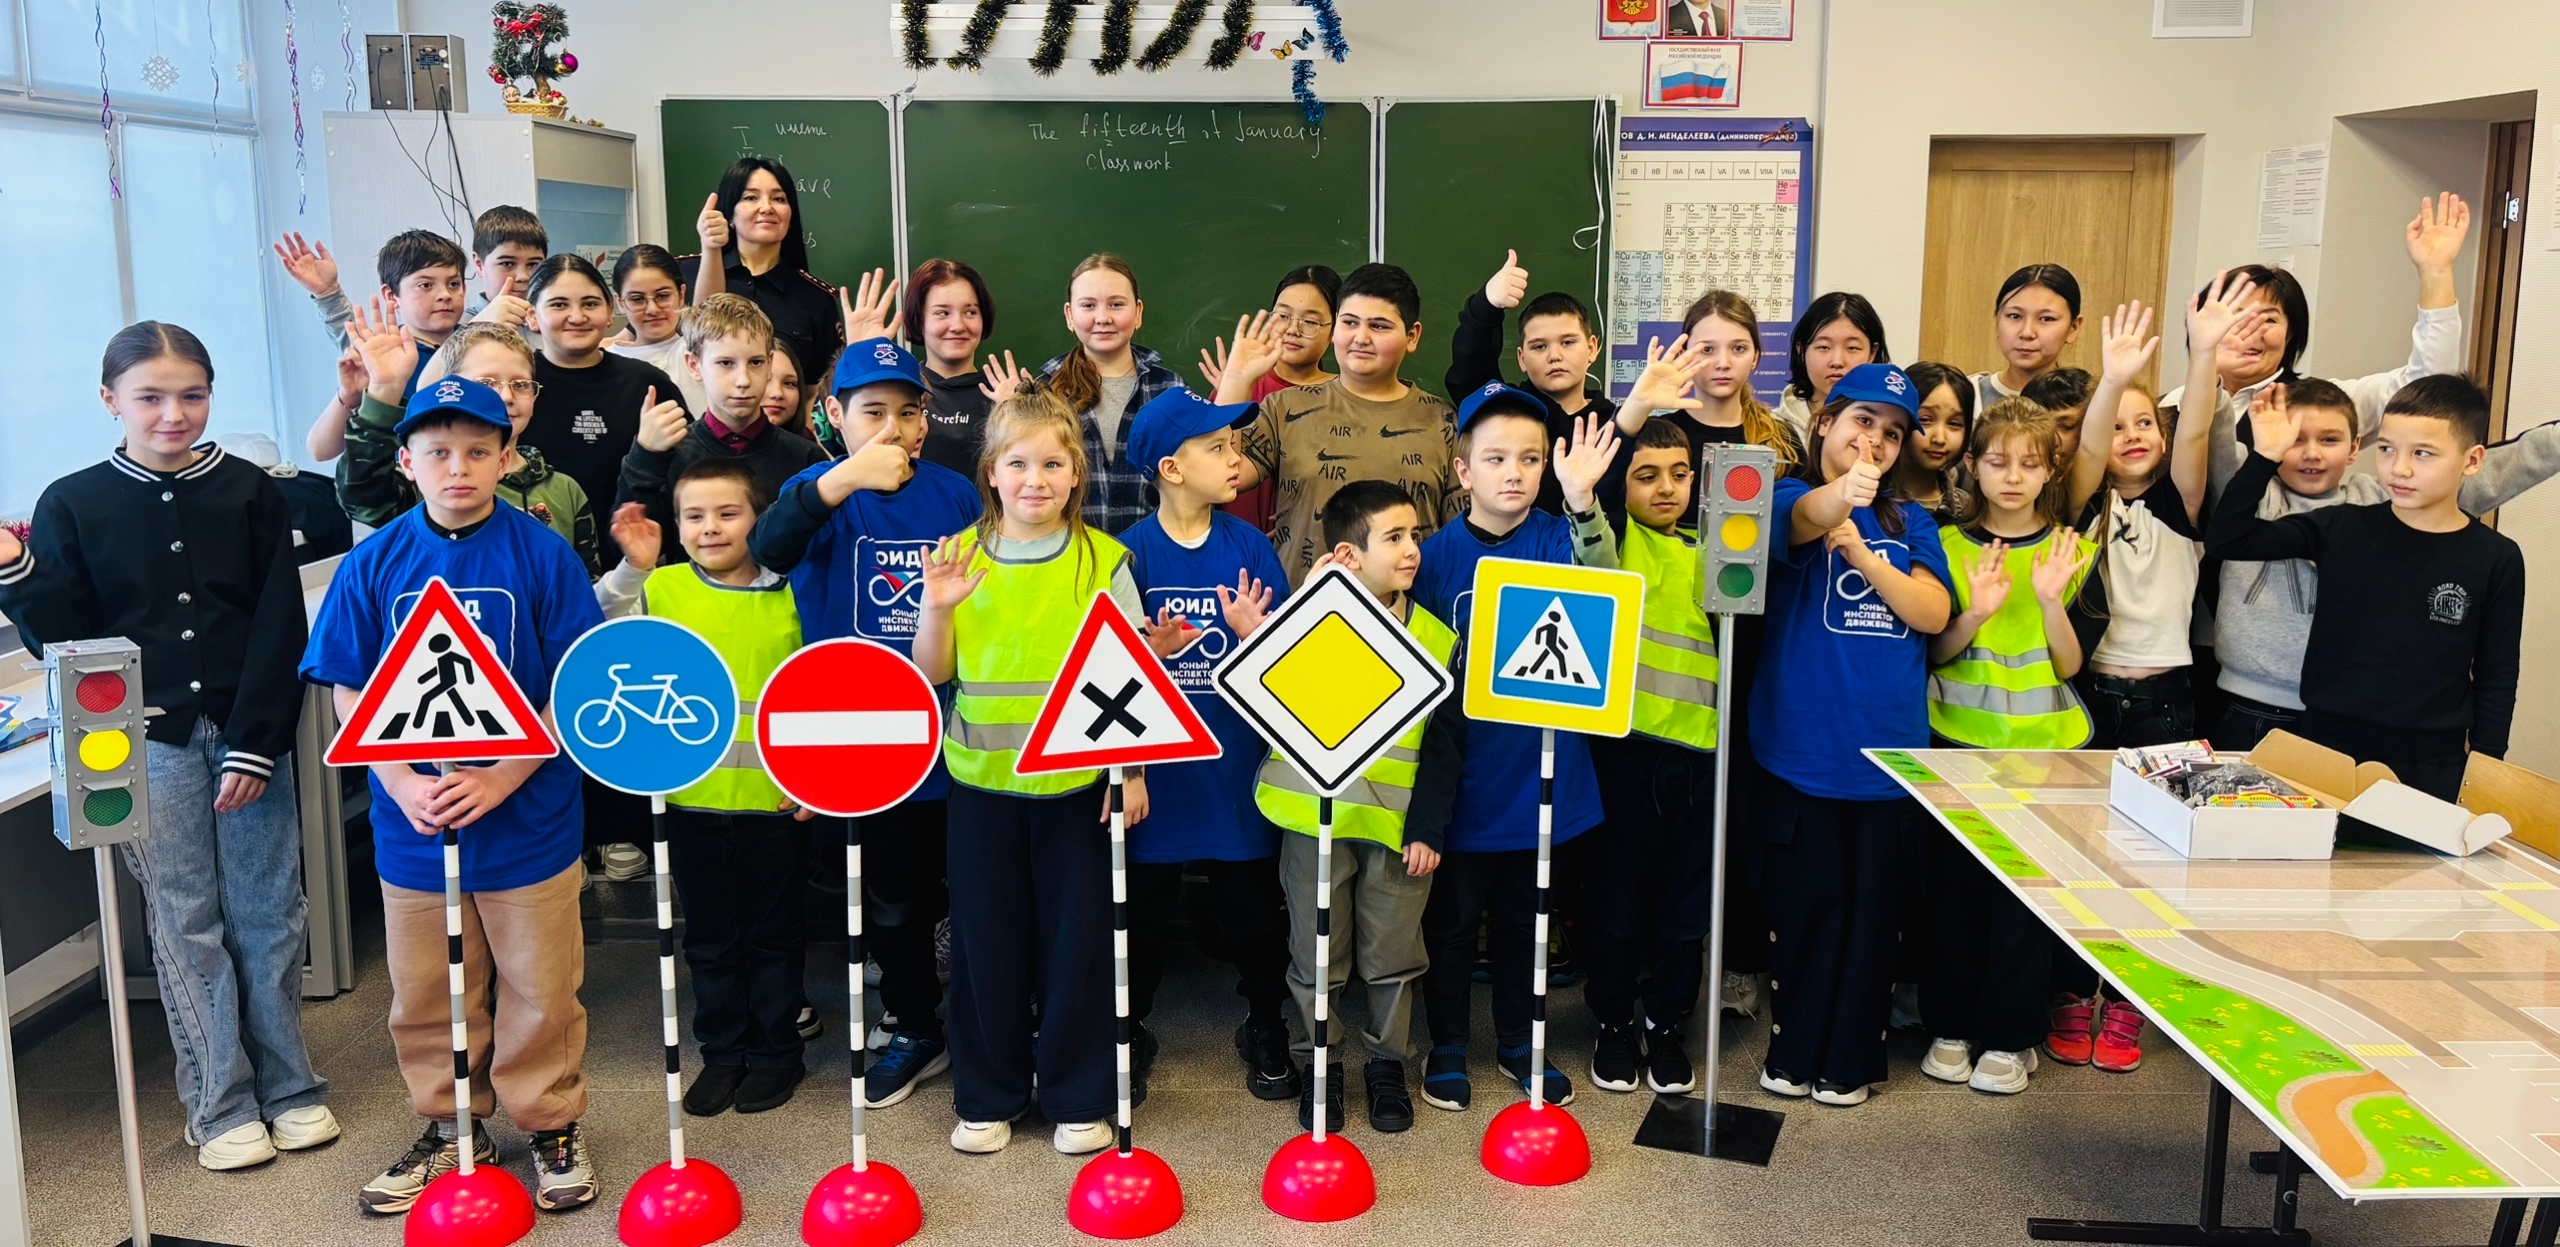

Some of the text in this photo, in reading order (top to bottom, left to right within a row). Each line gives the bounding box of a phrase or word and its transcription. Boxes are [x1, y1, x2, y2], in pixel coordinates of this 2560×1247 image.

[1029, 123, 1059, 140] The
[1080, 112, 1187, 140] fifteenth
[1659, 132, 1715, 141] МЕНДЕЛЕЕВА
[1418, 395, 1442, 404] AIR
[932, 411, 970, 425] careful
[1330, 425, 1352, 436] AIR
[1401, 453, 1424, 466] AIR
[1318, 463, 1348, 483] AIR
[1280, 479, 1299, 494] AIR
[1301, 537, 1315, 568] AIR
[1165, 598, 1217, 616] ЮИД
[1178, 660, 1210, 670] ЮНЫЙ
